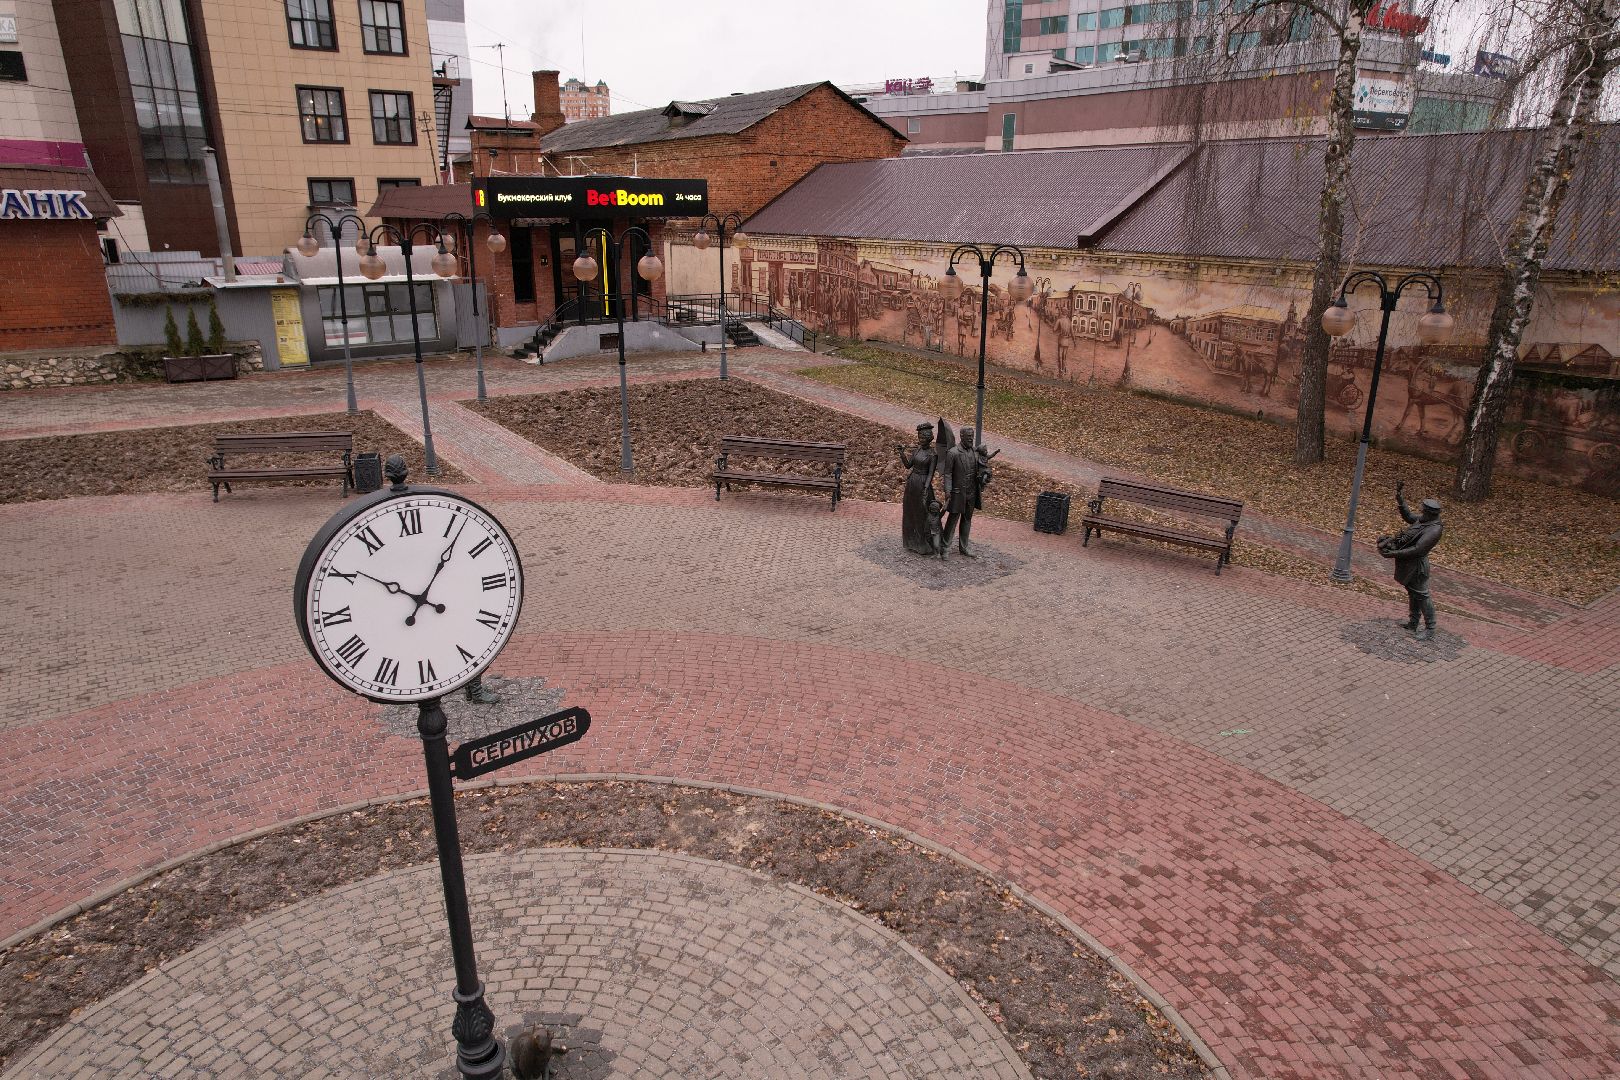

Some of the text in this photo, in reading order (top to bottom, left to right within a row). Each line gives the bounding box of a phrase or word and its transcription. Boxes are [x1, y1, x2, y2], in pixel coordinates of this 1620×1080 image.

[498, 193, 554, 203] Букмекерский
[555, 193, 573, 202] клуб
[587, 190, 664, 206] BetBoom
[675, 193, 684, 201] 24
[396, 508, 423, 538] XII
[443, 514, 457, 538] I
[354, 525, 385, 556] XI
[468, 536, 493, 559] II
[481, 572, 506, 592] III
[321, 606, 352, 628] IX
[475, 609, 501, 630] IV
[336, 634, 369, 669] VIII
[456, 644, 475, 665] V
[373, 657, 399, 686] VII
[417, 659, 437, 685] VI
[471, 718, 576, 766] СЕРПУХОВ
